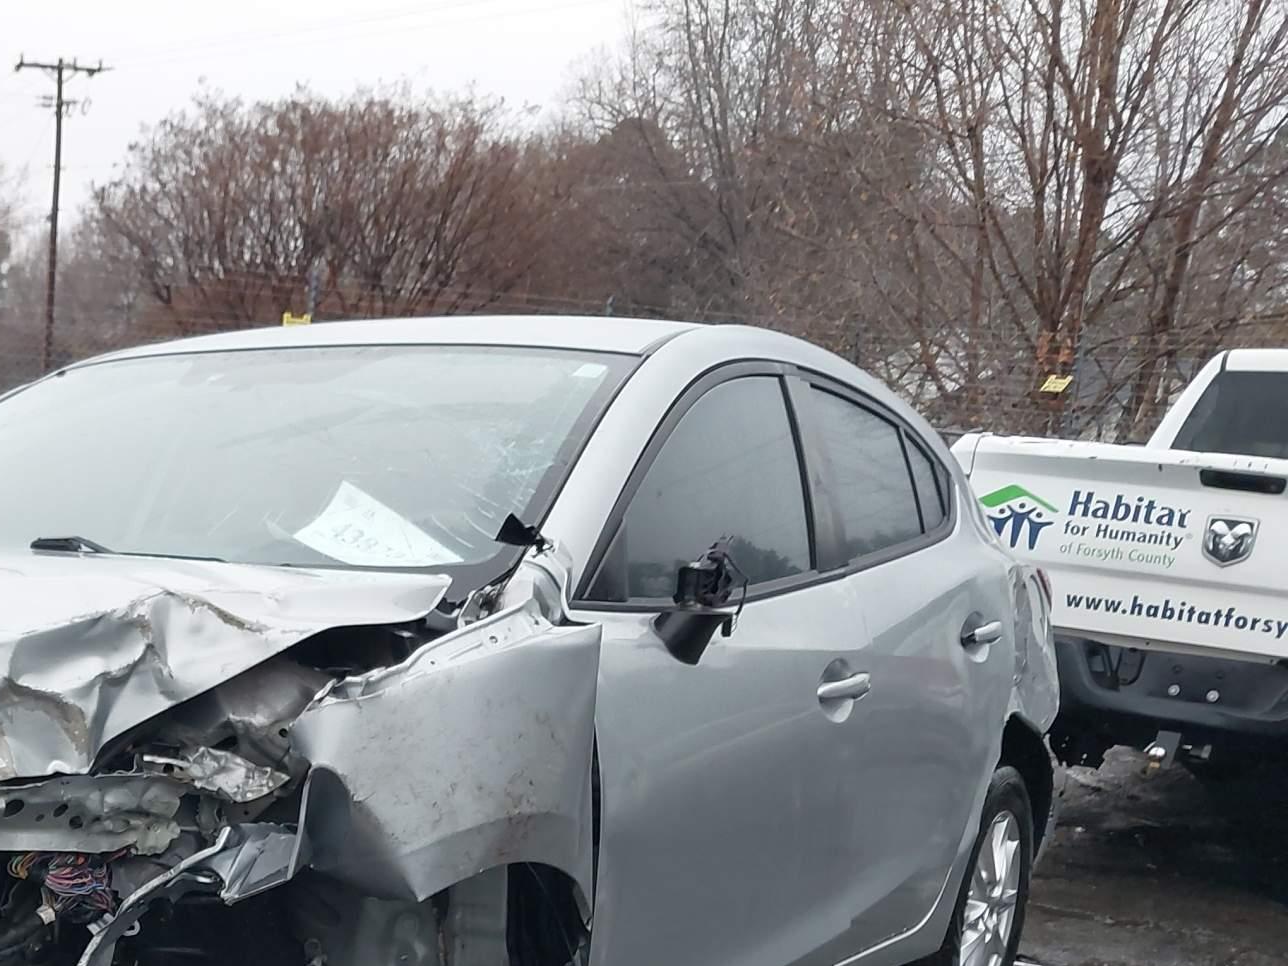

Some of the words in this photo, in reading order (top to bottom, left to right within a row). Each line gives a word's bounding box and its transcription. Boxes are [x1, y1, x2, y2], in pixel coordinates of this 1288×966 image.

[1064, 520, 1090, 536] for
[1095, 523, 1184, 550] Humanity
[1060, 542, 1073, 555] of
[1076, 543, 1123, 561] Forsyth
[1128, 548, 1175, 568] County
